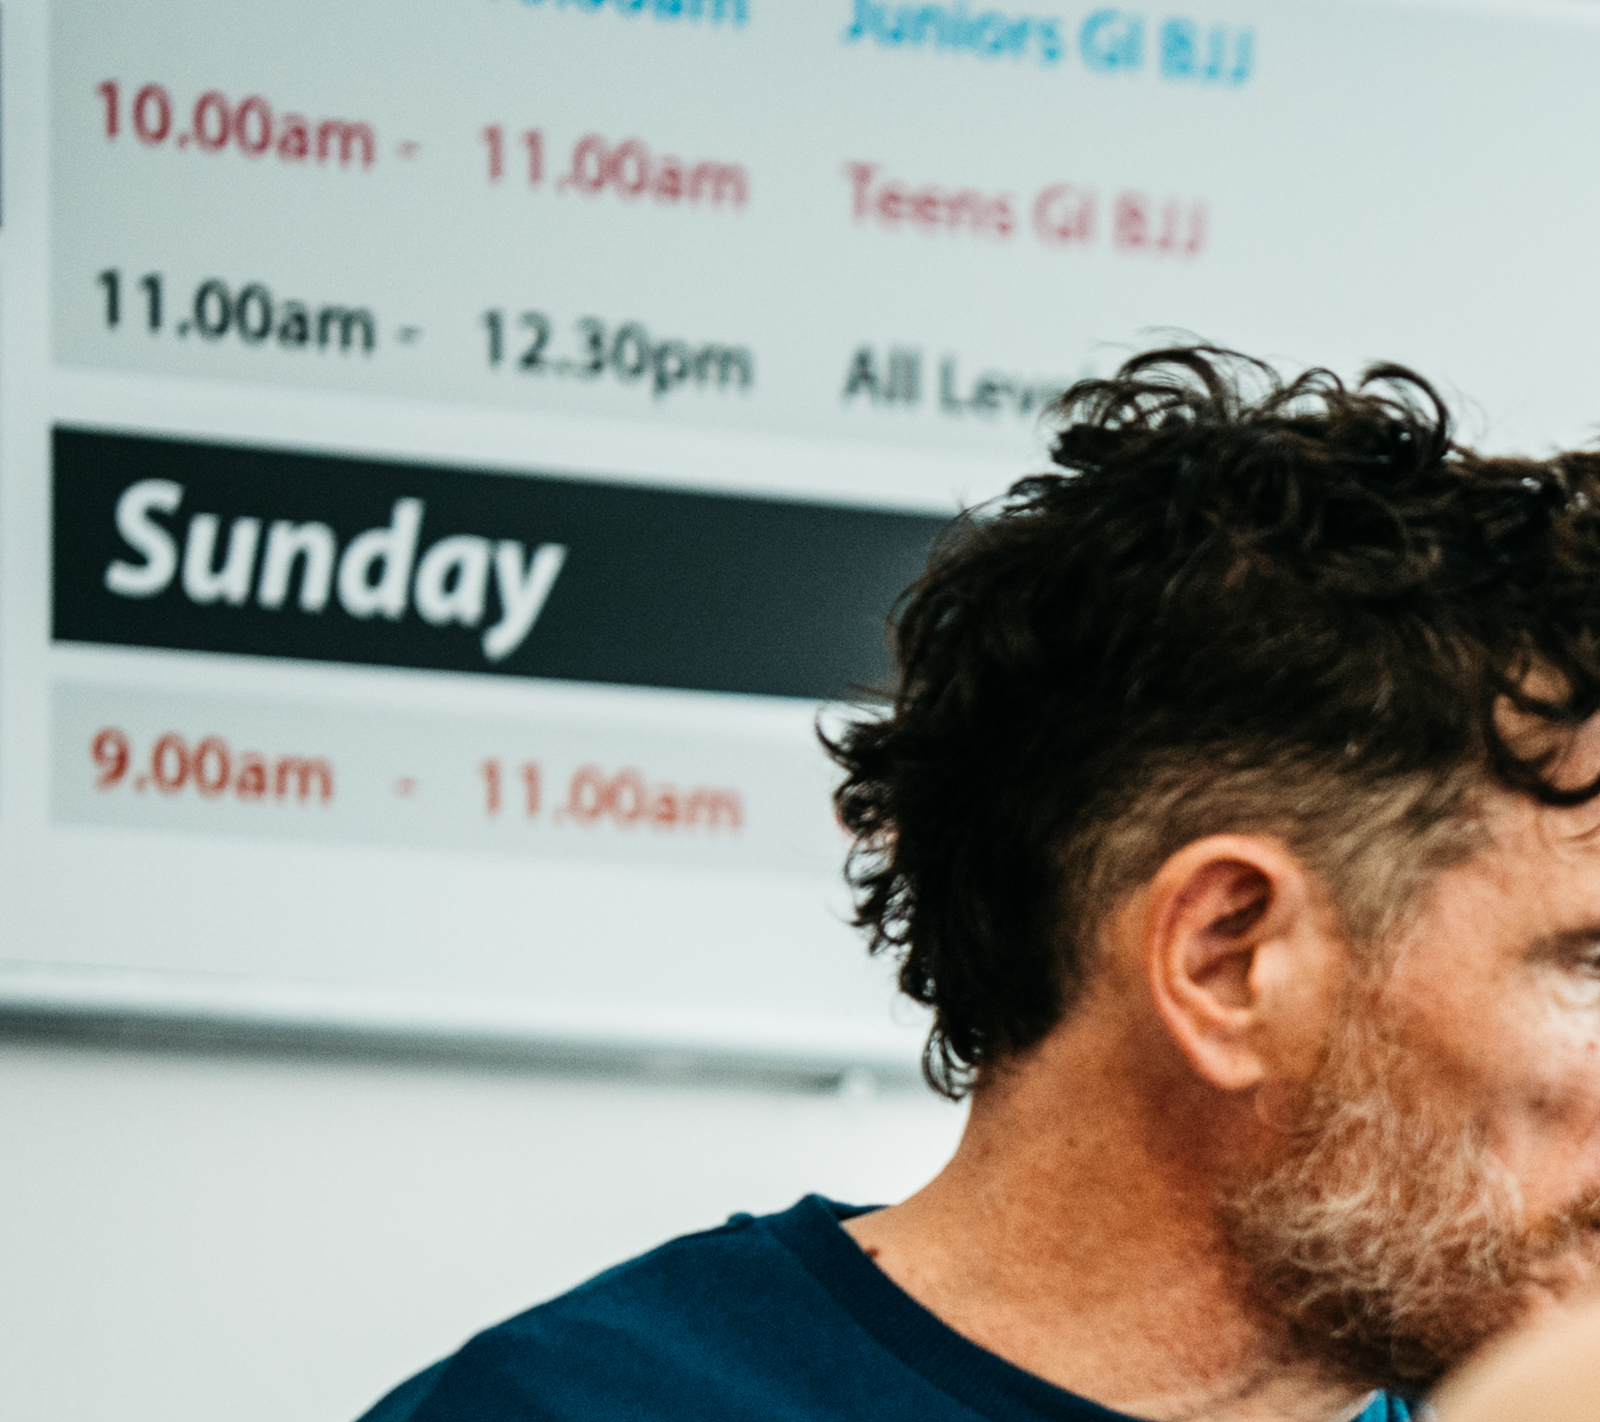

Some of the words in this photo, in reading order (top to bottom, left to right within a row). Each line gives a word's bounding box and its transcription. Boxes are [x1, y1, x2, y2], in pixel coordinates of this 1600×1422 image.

[96, 79, 376, 169] 10.00am
[478, 124, 750, 209] 11.00am
[842, 159, 1020, 244] Teens
[1111, 188, 1211, 258] BJJ
[96, 267, 376, 354] 11.00am
[478, 309, 755, 395] 12.30pm
[842, 346, 922, 410] All
[104, 477, 567, 662] Sunday
[91, 727, 334, 808] 9.00am
[478, 758, 745, 834] 11.00am
